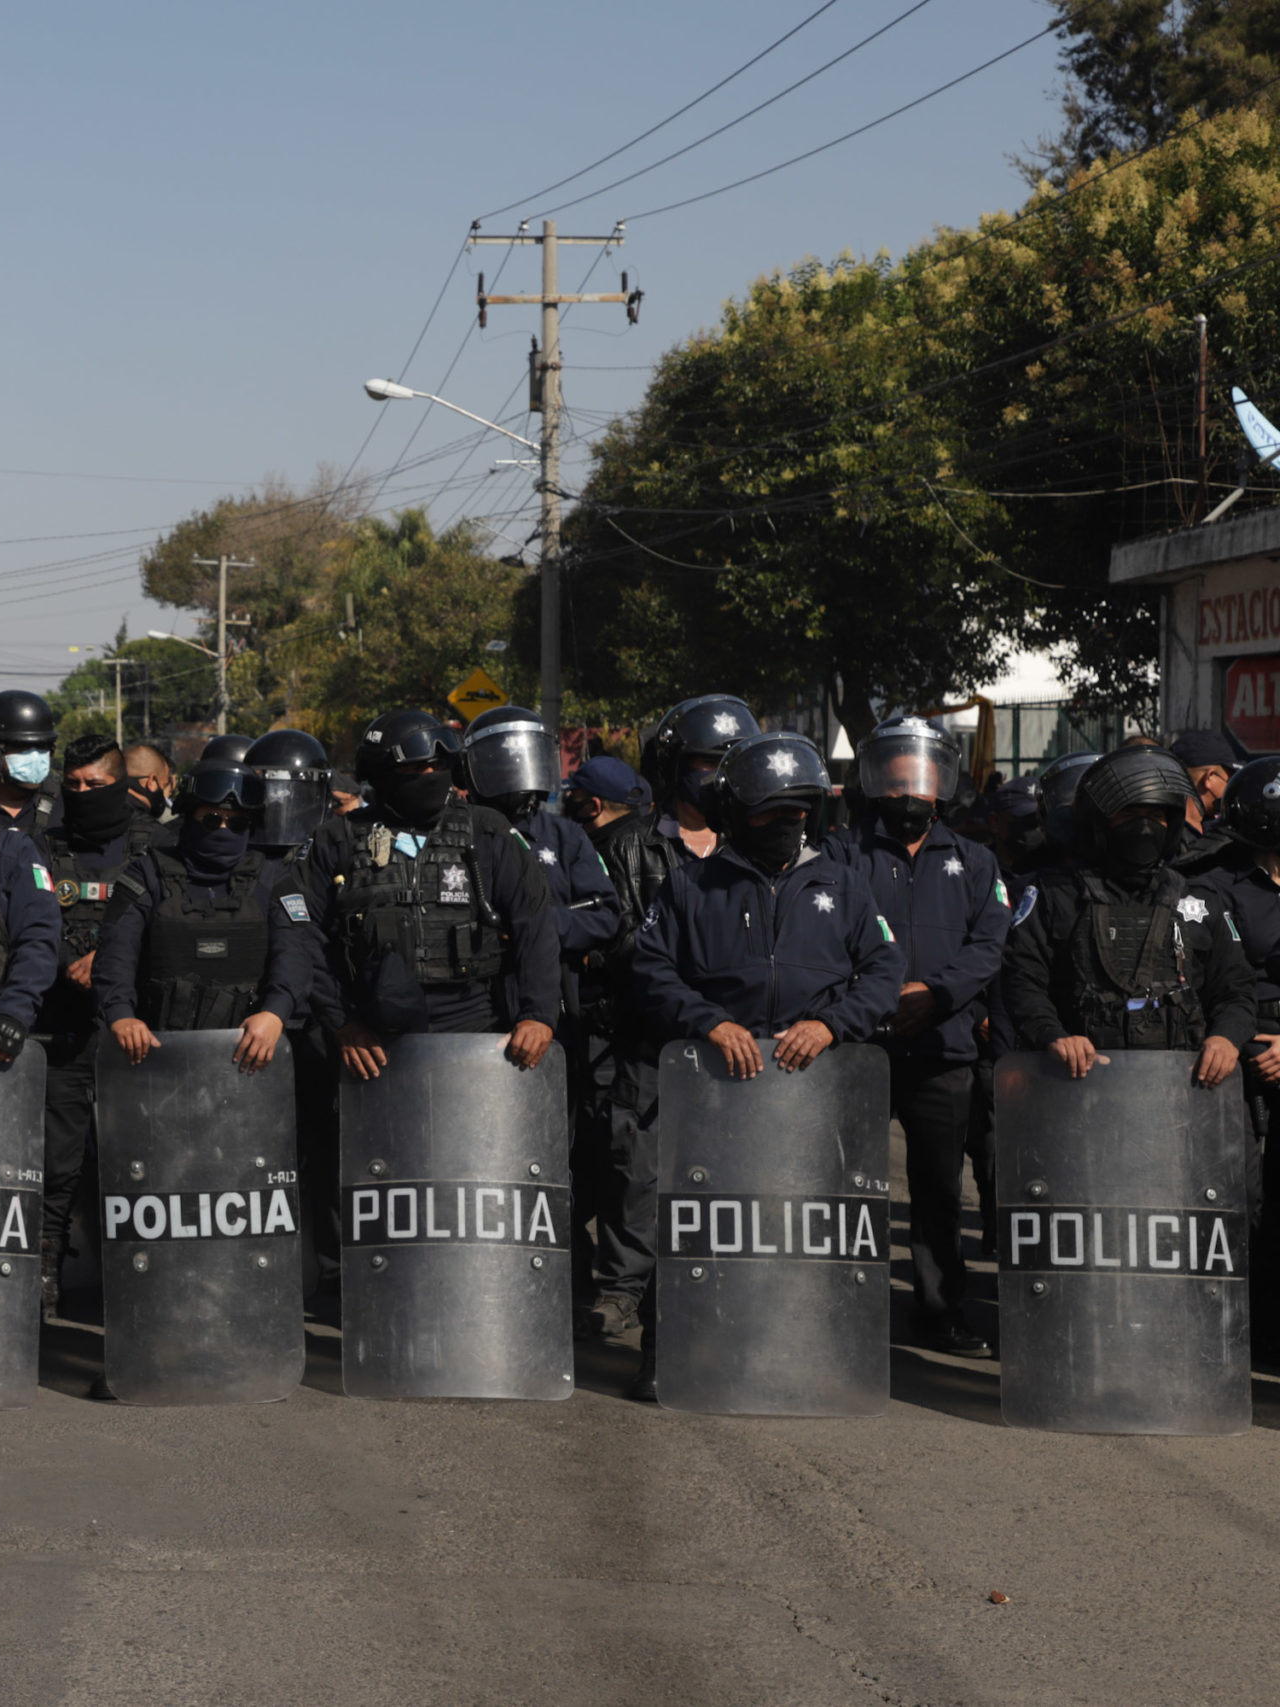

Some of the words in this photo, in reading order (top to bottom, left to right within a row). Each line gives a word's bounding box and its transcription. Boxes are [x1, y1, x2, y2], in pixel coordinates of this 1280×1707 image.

[105, 1189, 296, 1239] POLICIA
[352, 1187, 557, 1243] POLICIA
[670, 1200, 878, 1257] POLICIA
[1010, 1212, 1234, 1272] POLICIA
